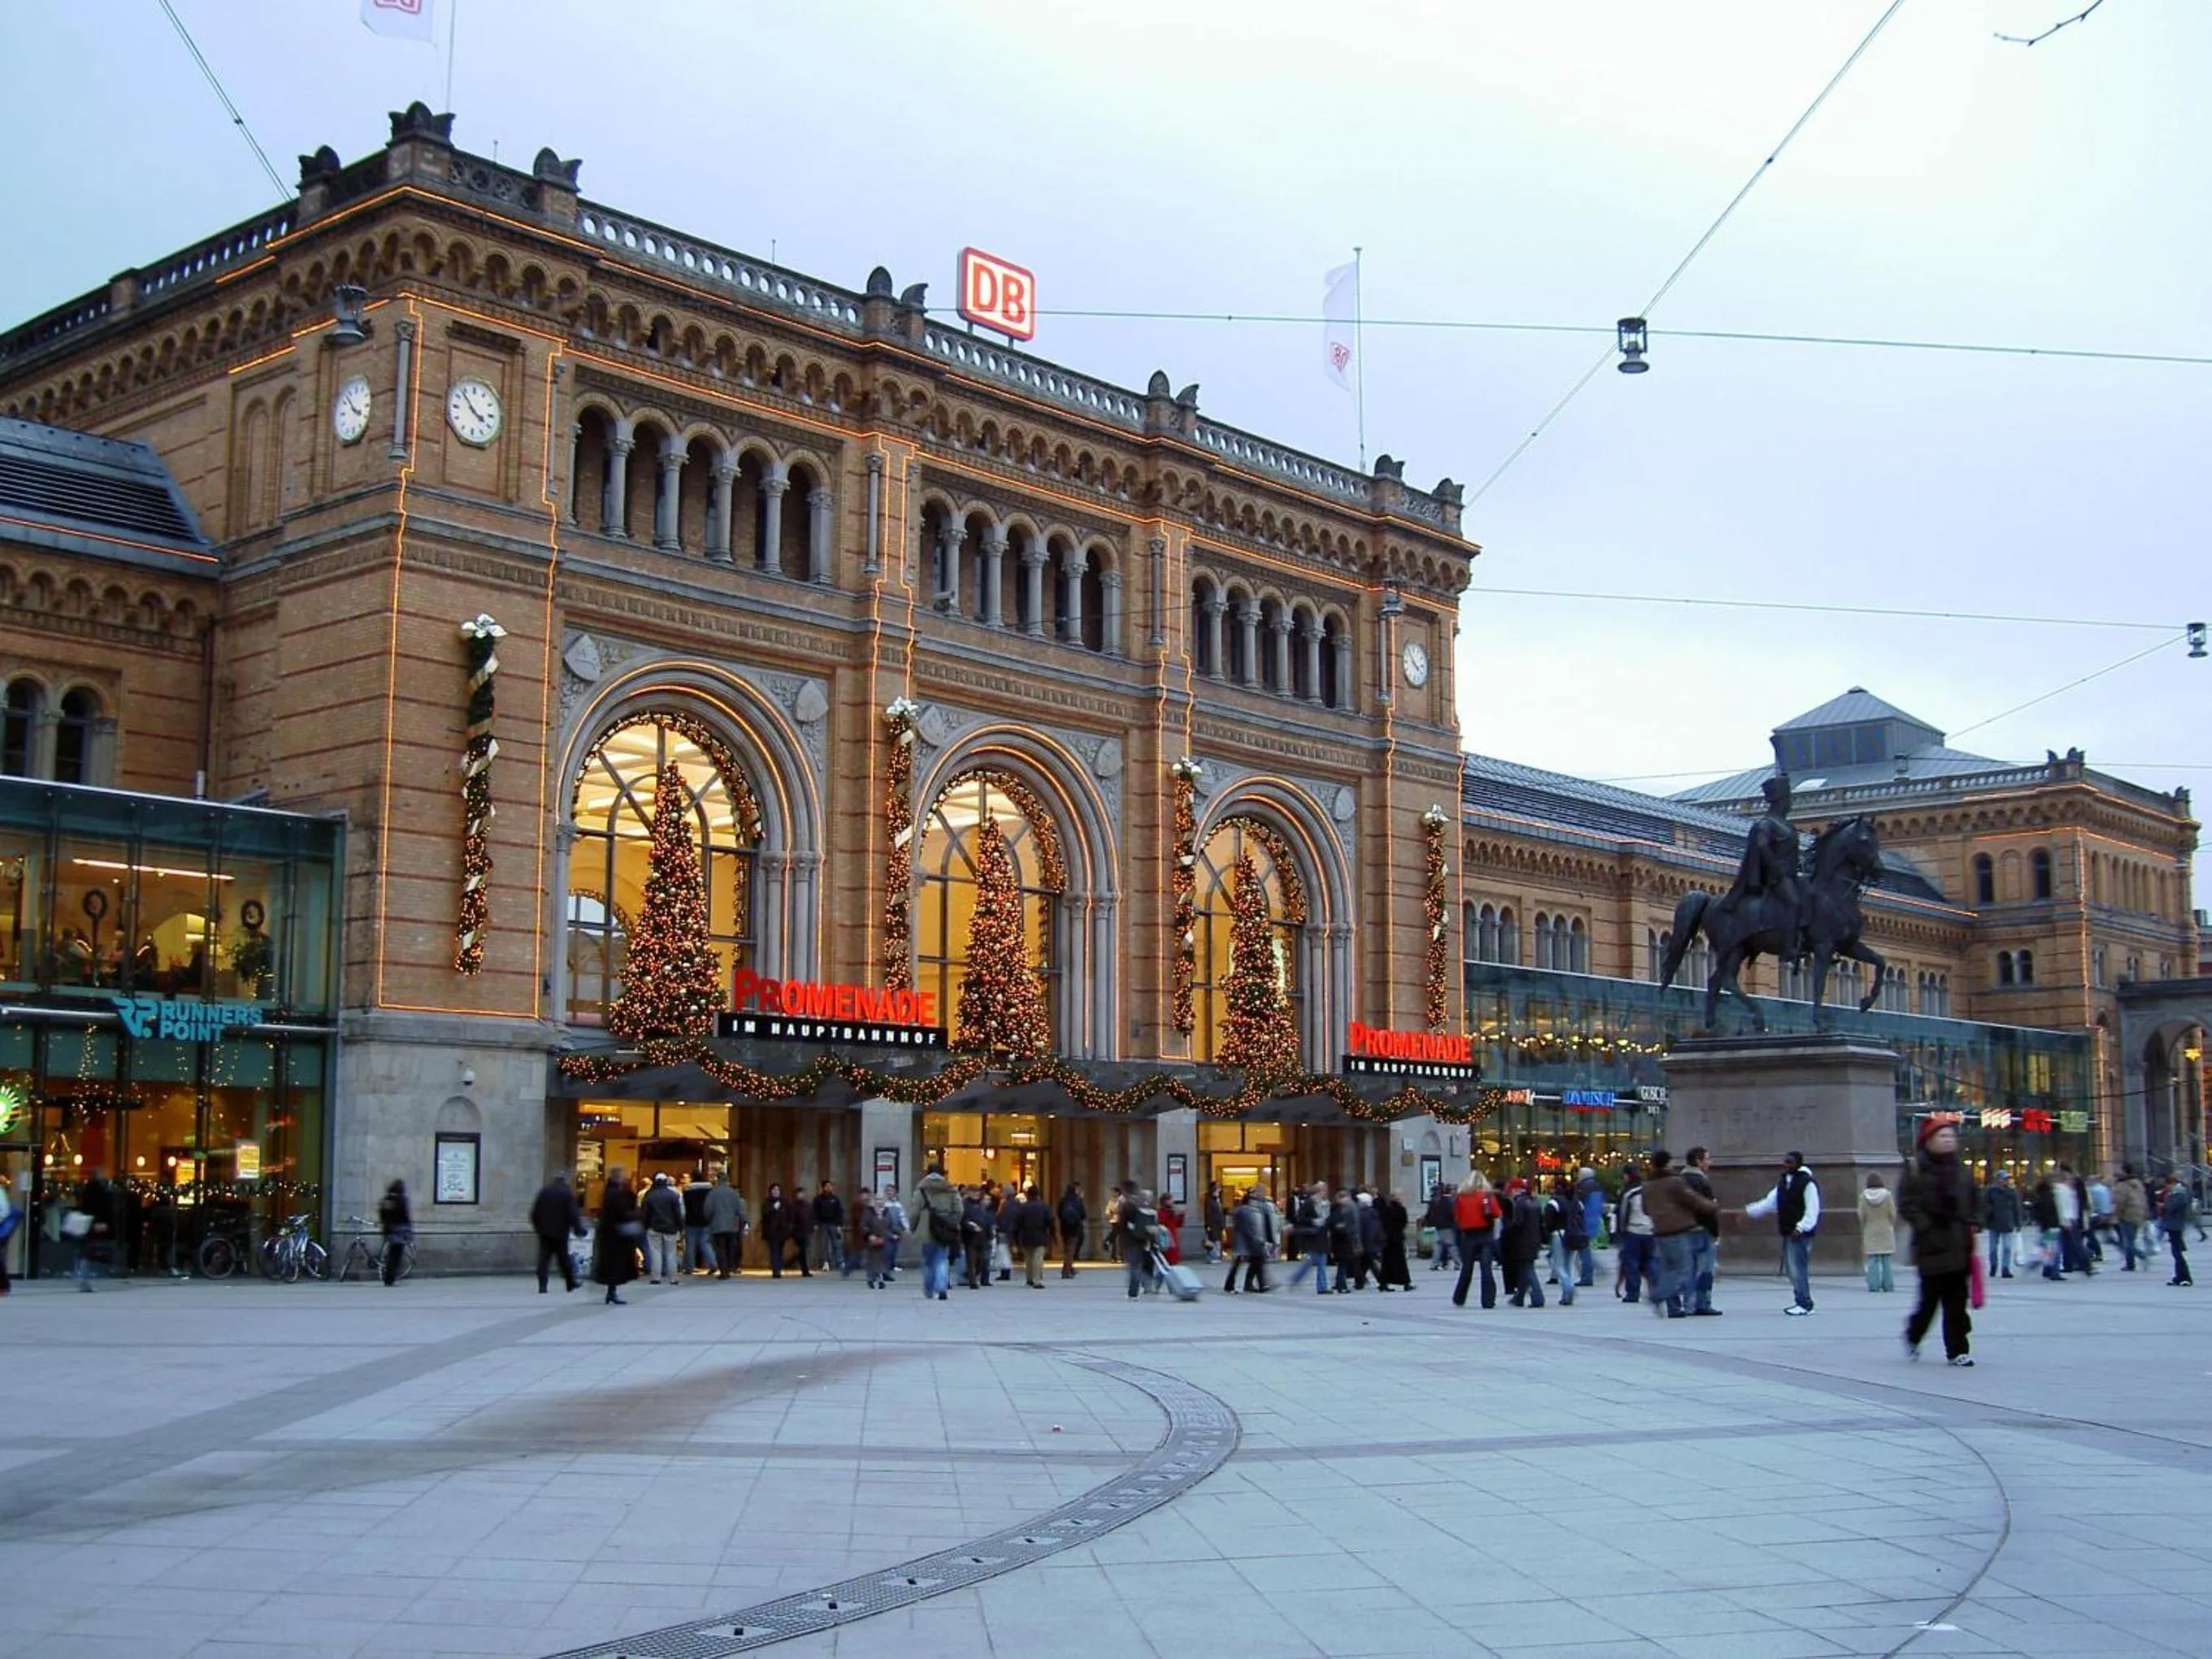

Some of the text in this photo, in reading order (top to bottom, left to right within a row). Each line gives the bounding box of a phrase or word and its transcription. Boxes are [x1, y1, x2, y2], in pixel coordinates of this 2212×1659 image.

[973, 261, 1026, 324] DB
[733, 967, 939, 1027] PROMENADE
[160, 1000, 262, 1025] RUNNERS
[159, 1020, 224, 1042] POINT
[732, 1019, 938, 1046] IM HAUPTBAHNHOF
[1349, 1020, 1474, 1063] PROMENADE
[1350, 1060, 1473, 1079] IM HAUPTBAHNHOF
